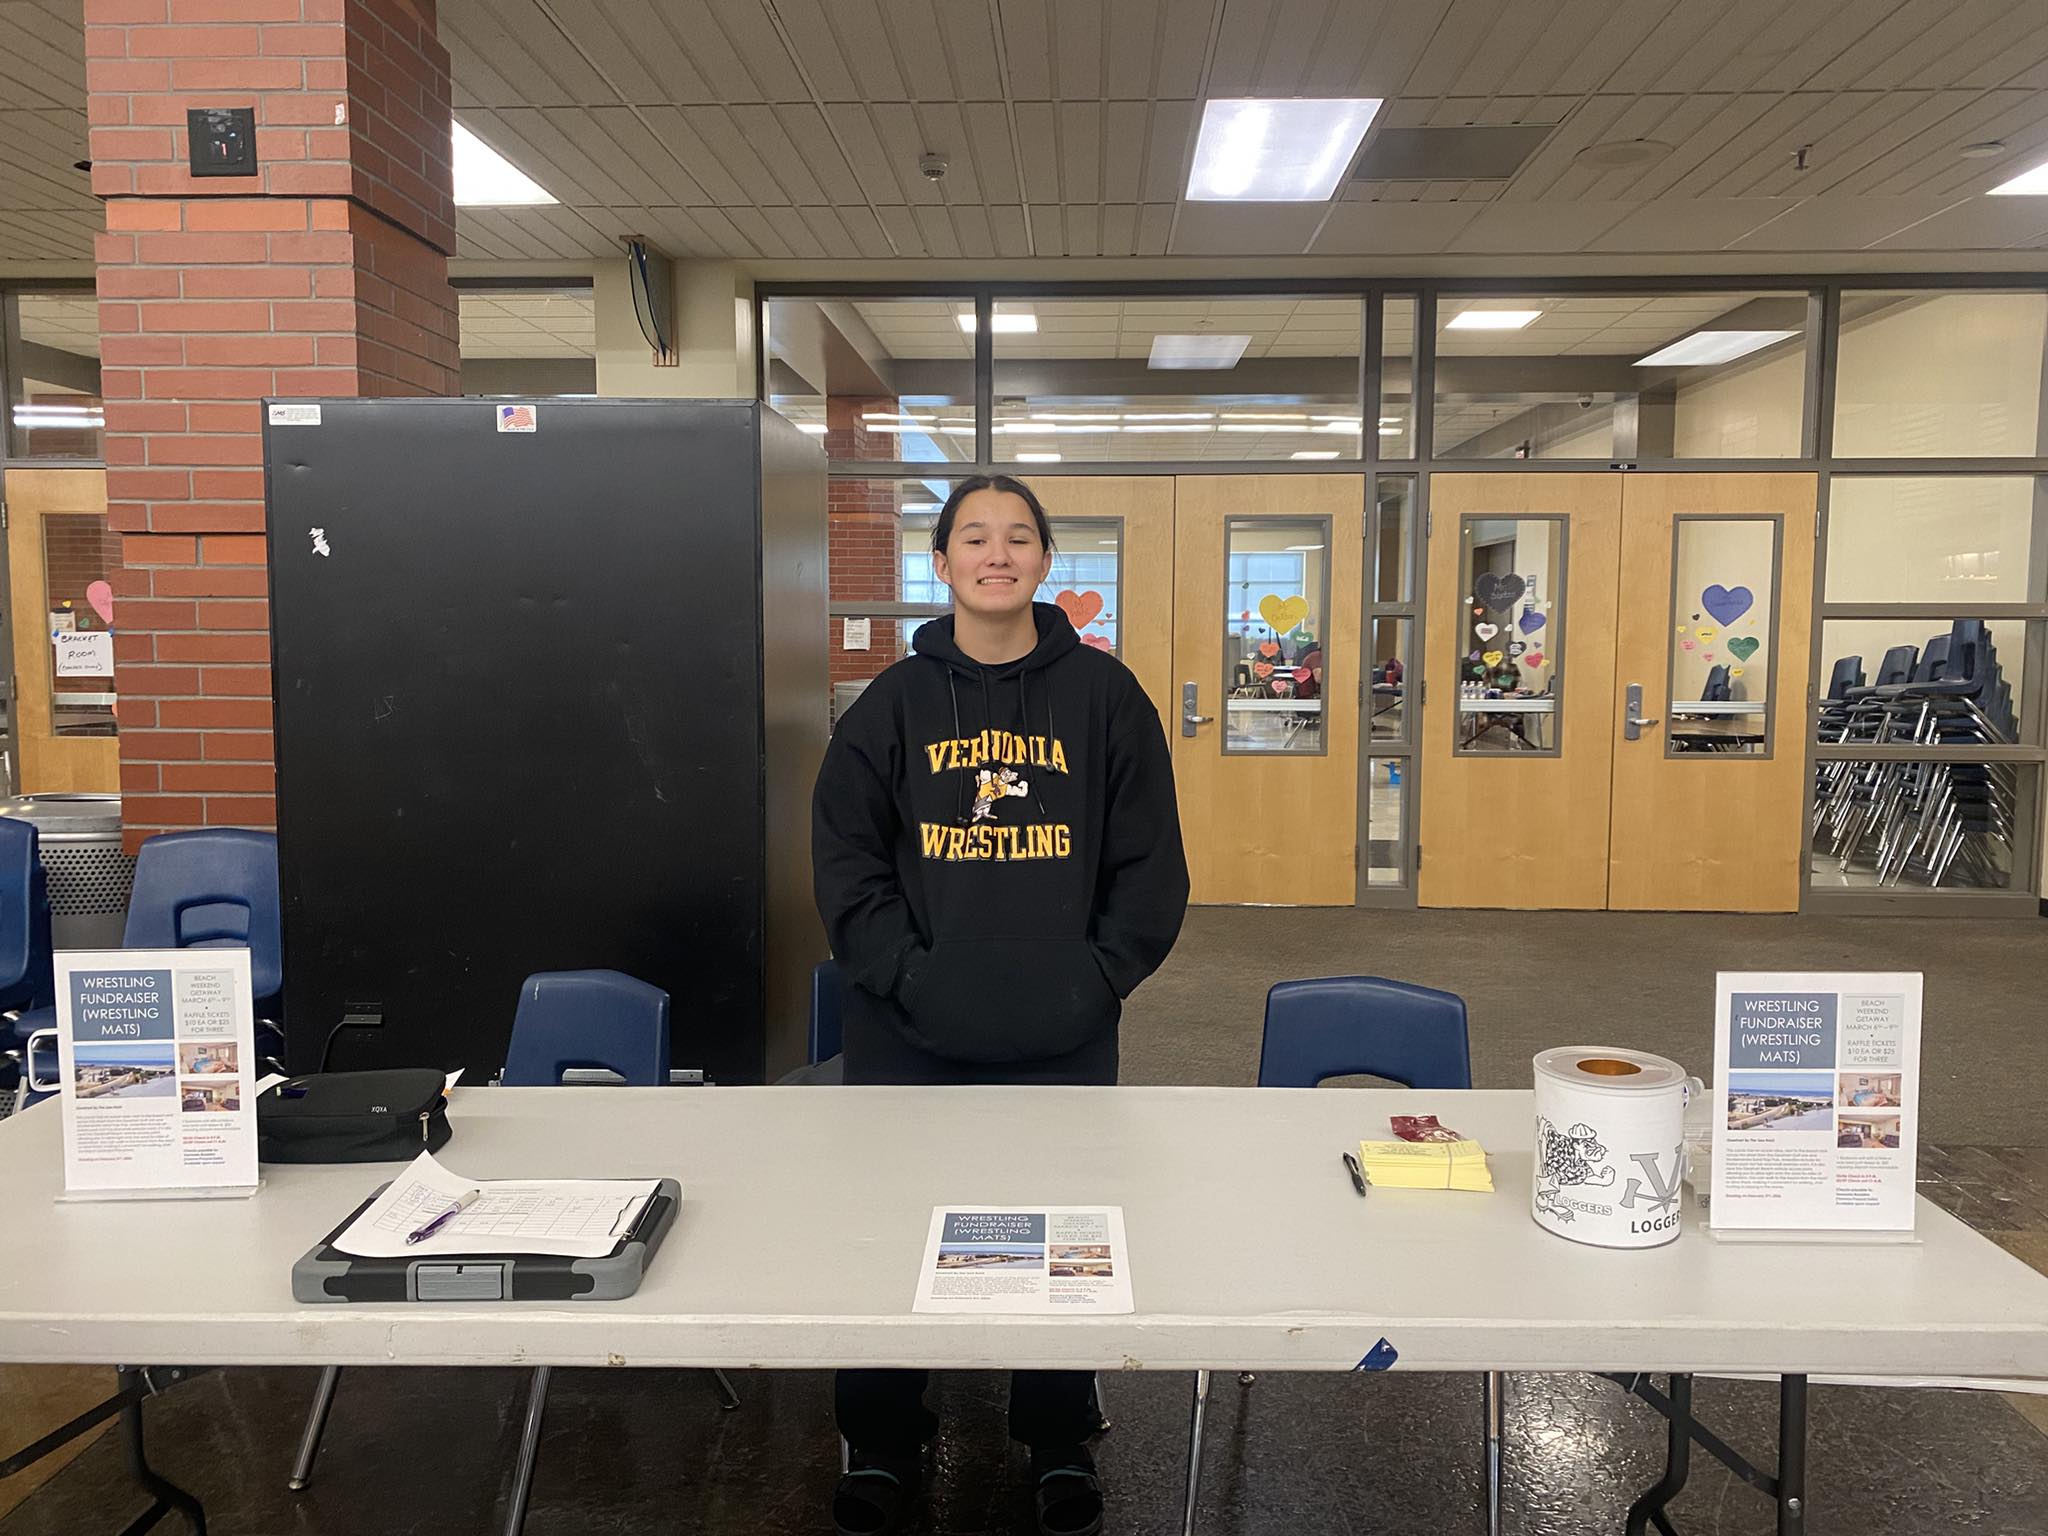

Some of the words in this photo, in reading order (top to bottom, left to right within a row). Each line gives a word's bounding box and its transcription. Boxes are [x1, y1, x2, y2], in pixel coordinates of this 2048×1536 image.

[920, 822, 1072, 862] WRESTLING
[83, 976, 155, 989] WRESTLING
[80, 992, 159, 1005] FUNDRAISER
[1744, 1000, 1820, 1012] WRESTLING
[83, 1008, 159, 1022] (WRESTLING
[101, 1023, 141, 1037] MATS)
[1740, 1017, 1823, 1029] FUNDRAISER
[1741, 1034, 1822, 1048] (WRESTLING
[1759, 1050, 1801, 1064] MATS)
[1554, 1193, 1612, 1216] LOGGERS
